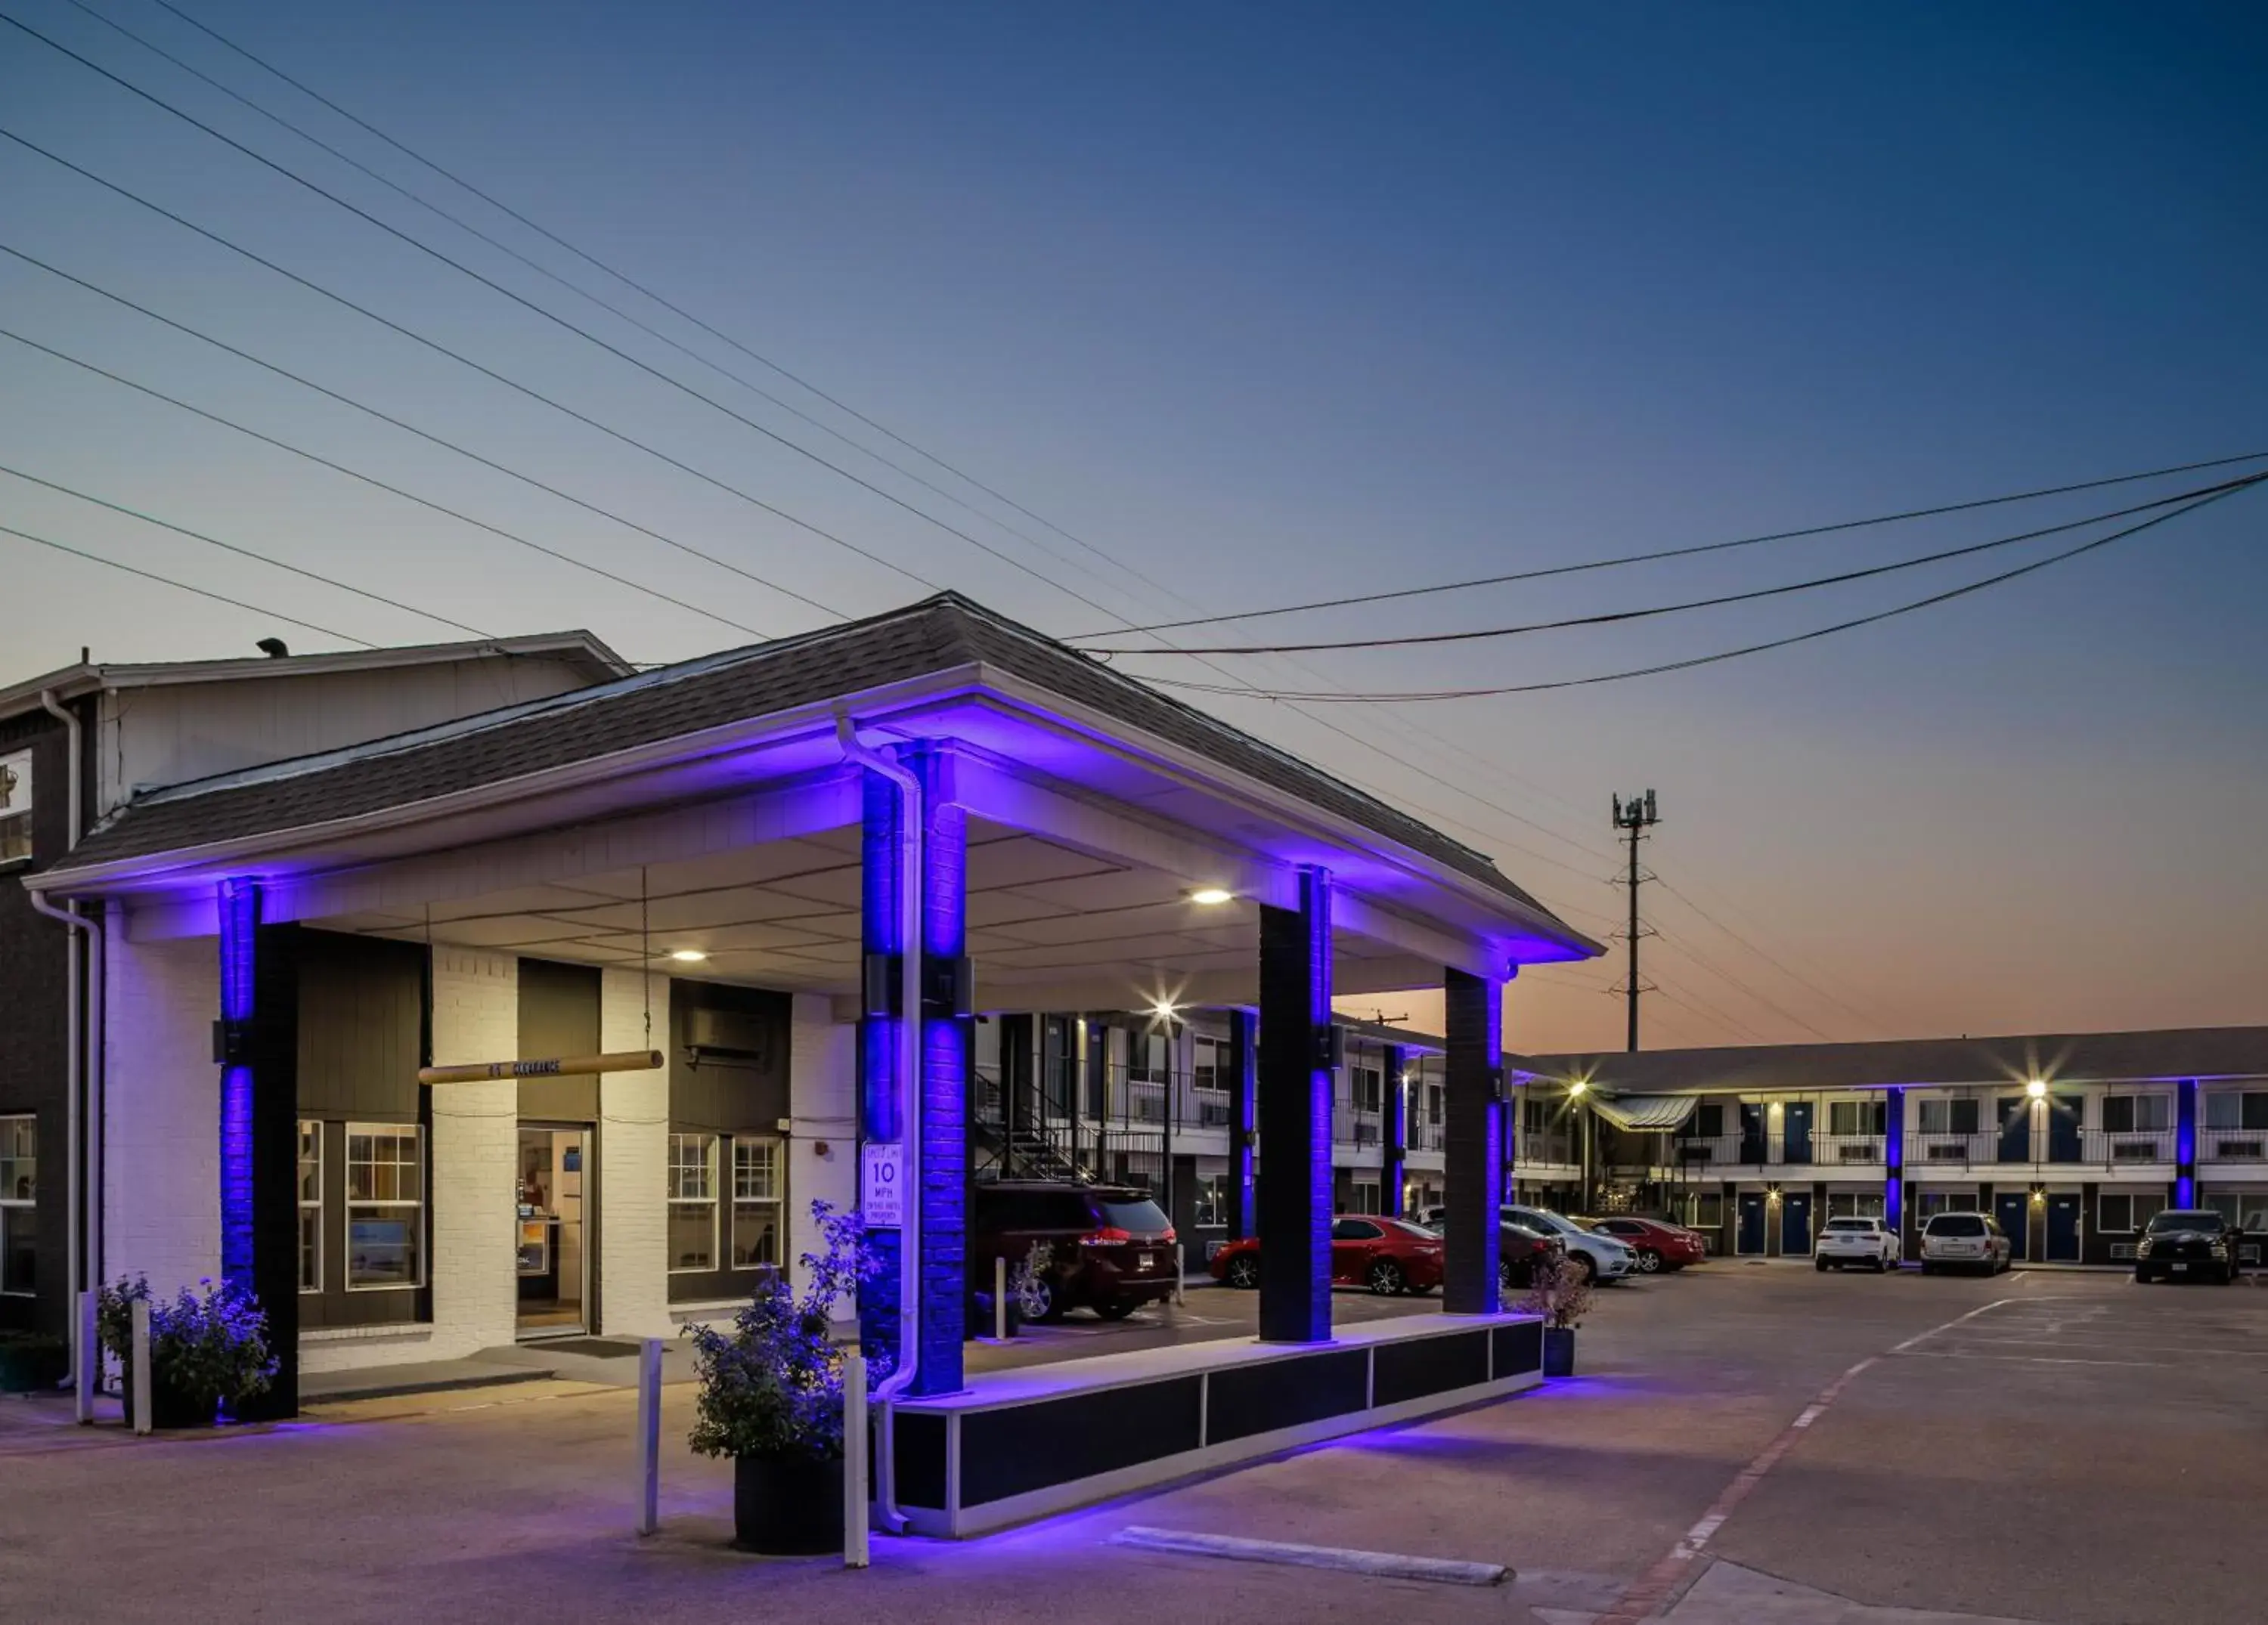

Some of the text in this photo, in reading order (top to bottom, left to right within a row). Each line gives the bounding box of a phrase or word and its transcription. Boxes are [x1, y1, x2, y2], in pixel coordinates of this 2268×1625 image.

[514, 1060, 560, 1076] CLEARANCE
[873, 1162, 894, 1183] 10
[875, 1187, 893, 1199] MPH
